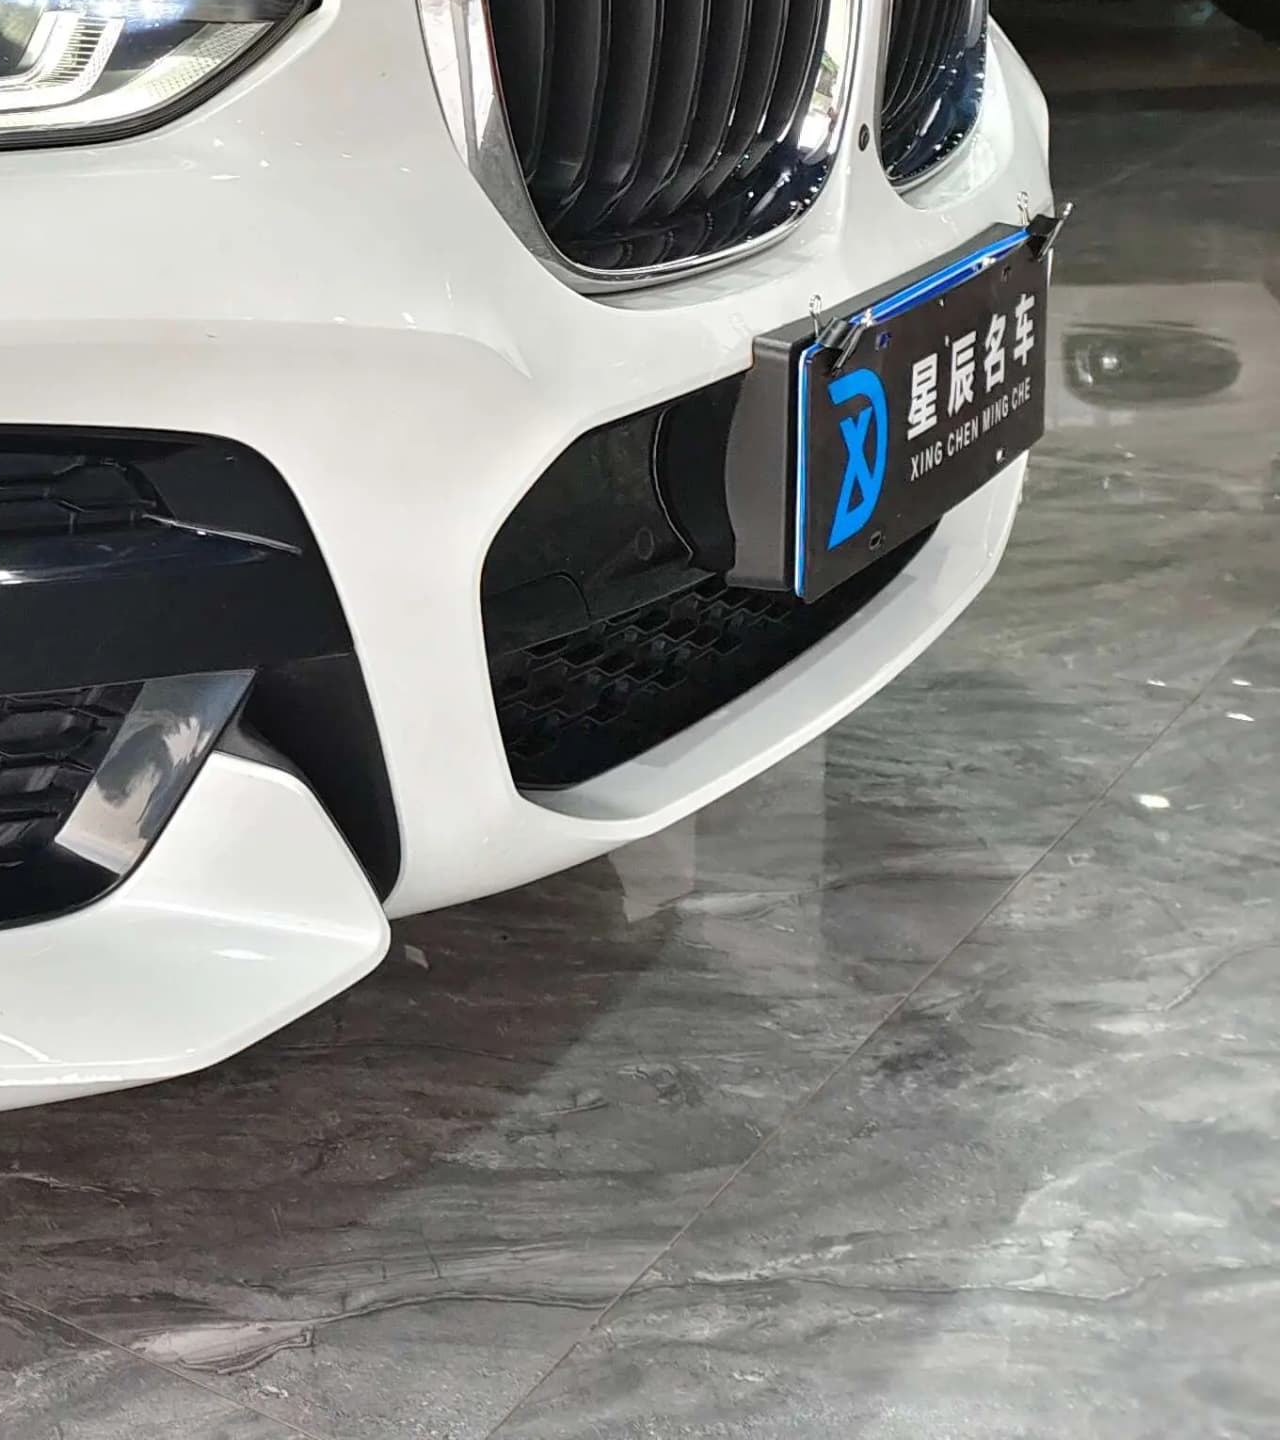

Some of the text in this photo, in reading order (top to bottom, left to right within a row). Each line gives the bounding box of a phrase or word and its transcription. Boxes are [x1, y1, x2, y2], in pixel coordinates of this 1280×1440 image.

[907, 293, 1035, 441] 星辰名车
[910, 375, 1032, 481] XING CHEN MING CHE
